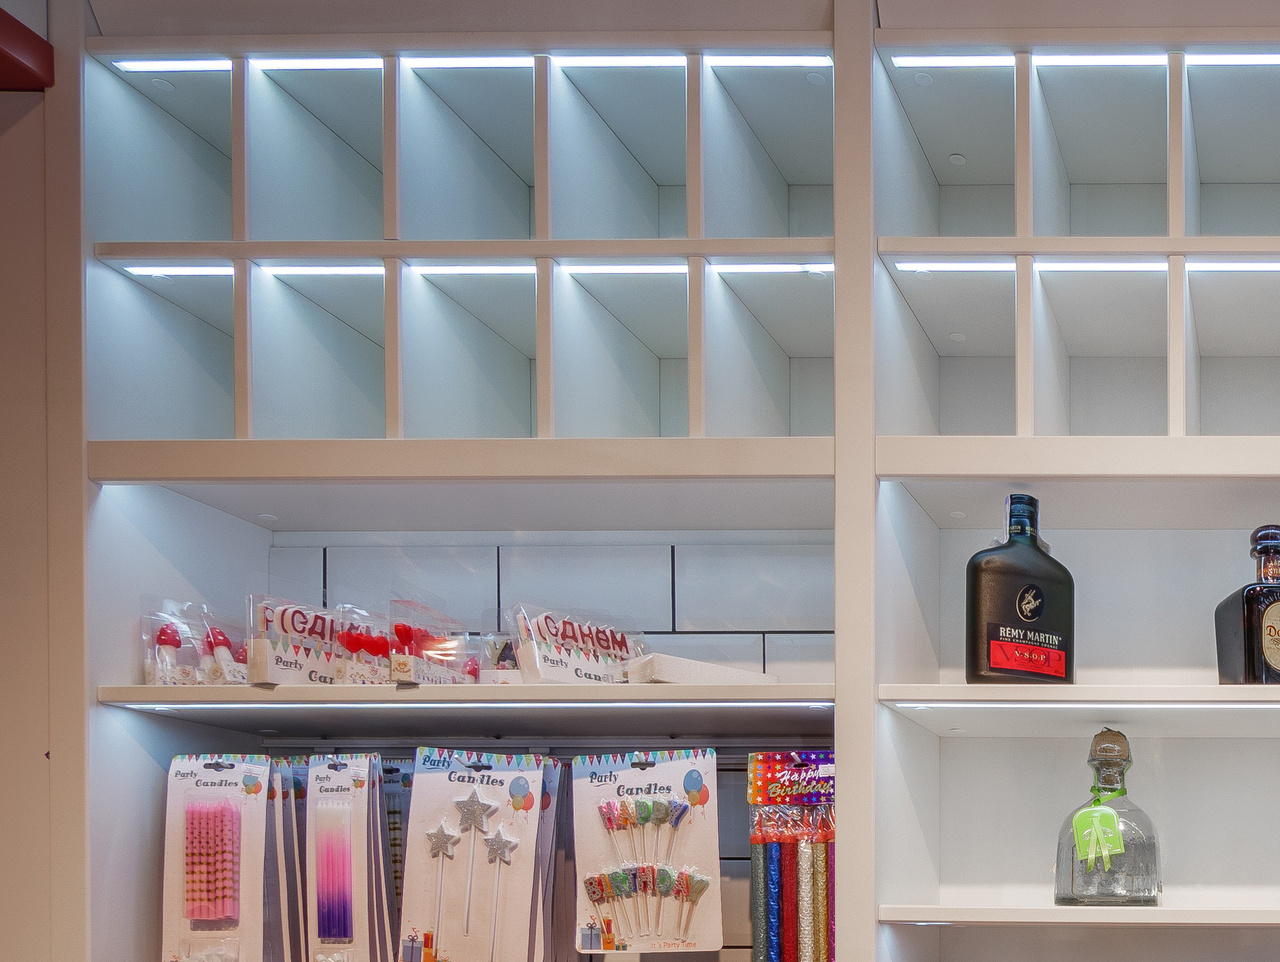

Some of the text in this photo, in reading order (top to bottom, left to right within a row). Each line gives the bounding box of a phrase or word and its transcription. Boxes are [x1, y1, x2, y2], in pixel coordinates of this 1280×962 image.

[1000, 627, 1058, 645] RÉMY MARTIN
[542, 655, 568, 669] Party
[422, 755, 452, 769] Party
[174, 770, 198, 780] Party
[315, 775, 332, 784] Party
[448, 771, 504, 787] Candles
[589, 771, 618, 784] Party
[778, 769, 821, 784] Happy
[195, 779, 238, 788] Candles
[319, 785, 350, 794] Candles
[617, 783, 672, 796] Candles
[768, 781, 832, 797] Birthday
